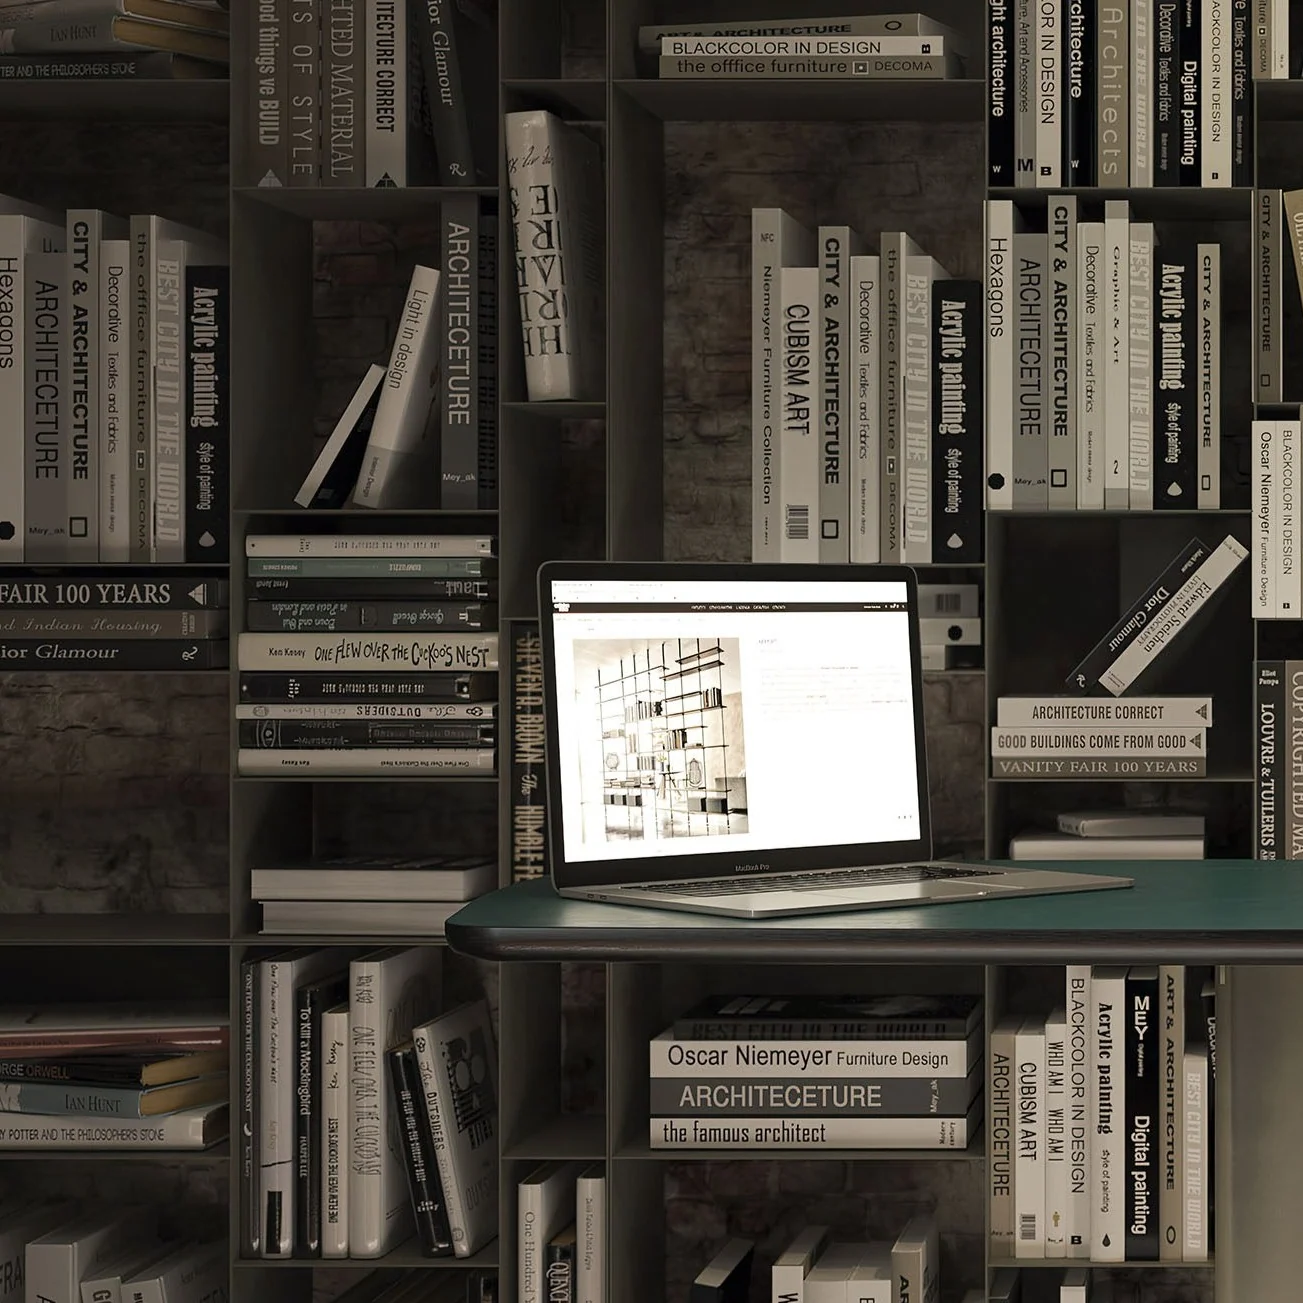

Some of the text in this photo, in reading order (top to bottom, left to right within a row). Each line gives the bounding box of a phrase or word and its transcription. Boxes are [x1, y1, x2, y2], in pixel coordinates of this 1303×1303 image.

[673, 40, 881, 55] BLACKCOLOR IN DESIGN
[678, 59, 705, 73] the
[771, 59, 847, 73] furniture
[874, 61, 932, 71] DECOMA
[1102, 7, 1123, 176] Architects
[292, 44, 313, 175] OF STYLE
[1181, 61, 1197, 165] Digital painting
[786, 304, 810, 434] CUBISM ART
[1261, 432, 1271, 470] Oscar
[1259, 474, 1271, 534] Niemeyer
[1033, 706, 1164, 719] ARCHITECTURE CORRECT
[999, 736, 1186, 748] GOOD BUILDINGS COME FROM GOOD
[1261, 703, 1274, 764] LOUVRE
[1261, 768, 1271, 776] &
[668, 1045, 948, 1070] Oscar Niemeyer Furniture Design
[680, 1086, 881, 1107] ARCHITECETURE
[663, 1121, 826, 1143] the famous architect
[1131, 1116, 1150, 1235] Digital painting
